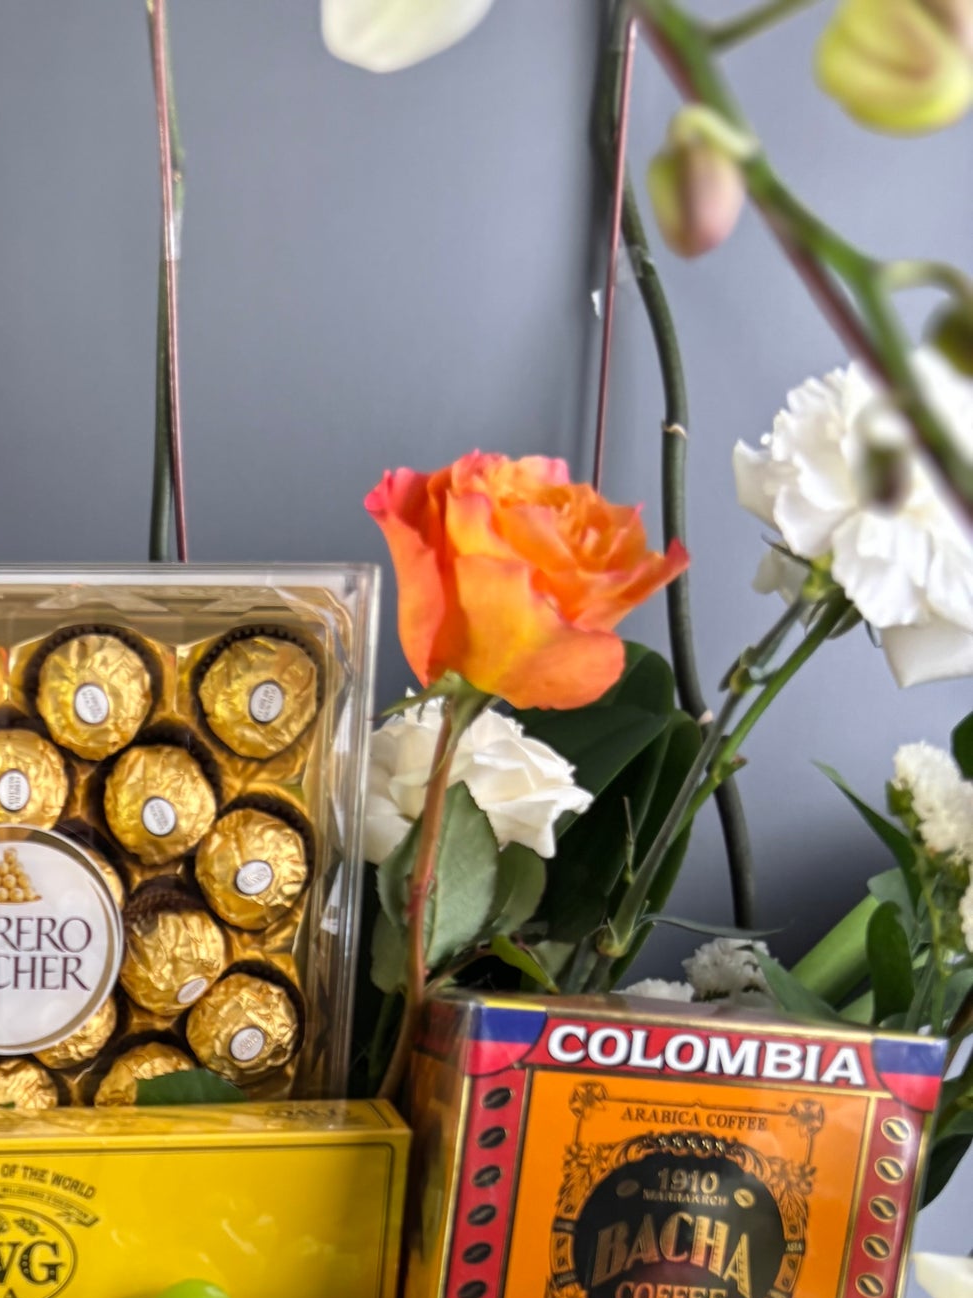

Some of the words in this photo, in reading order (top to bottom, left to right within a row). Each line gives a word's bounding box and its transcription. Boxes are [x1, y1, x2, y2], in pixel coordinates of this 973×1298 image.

[546, 1024, 865, 1086] COLOMBIA
[621, 1107, 701, 1127] ARABICA
[706, 1112, 769, 1131] COFFEE
[0, 1163, 17, 1179] OF
[21, 1164, 49, 1184] THE
[50, 1170, 97, 1200] WORLD
[658, 1166, 720, 1195] 1910
